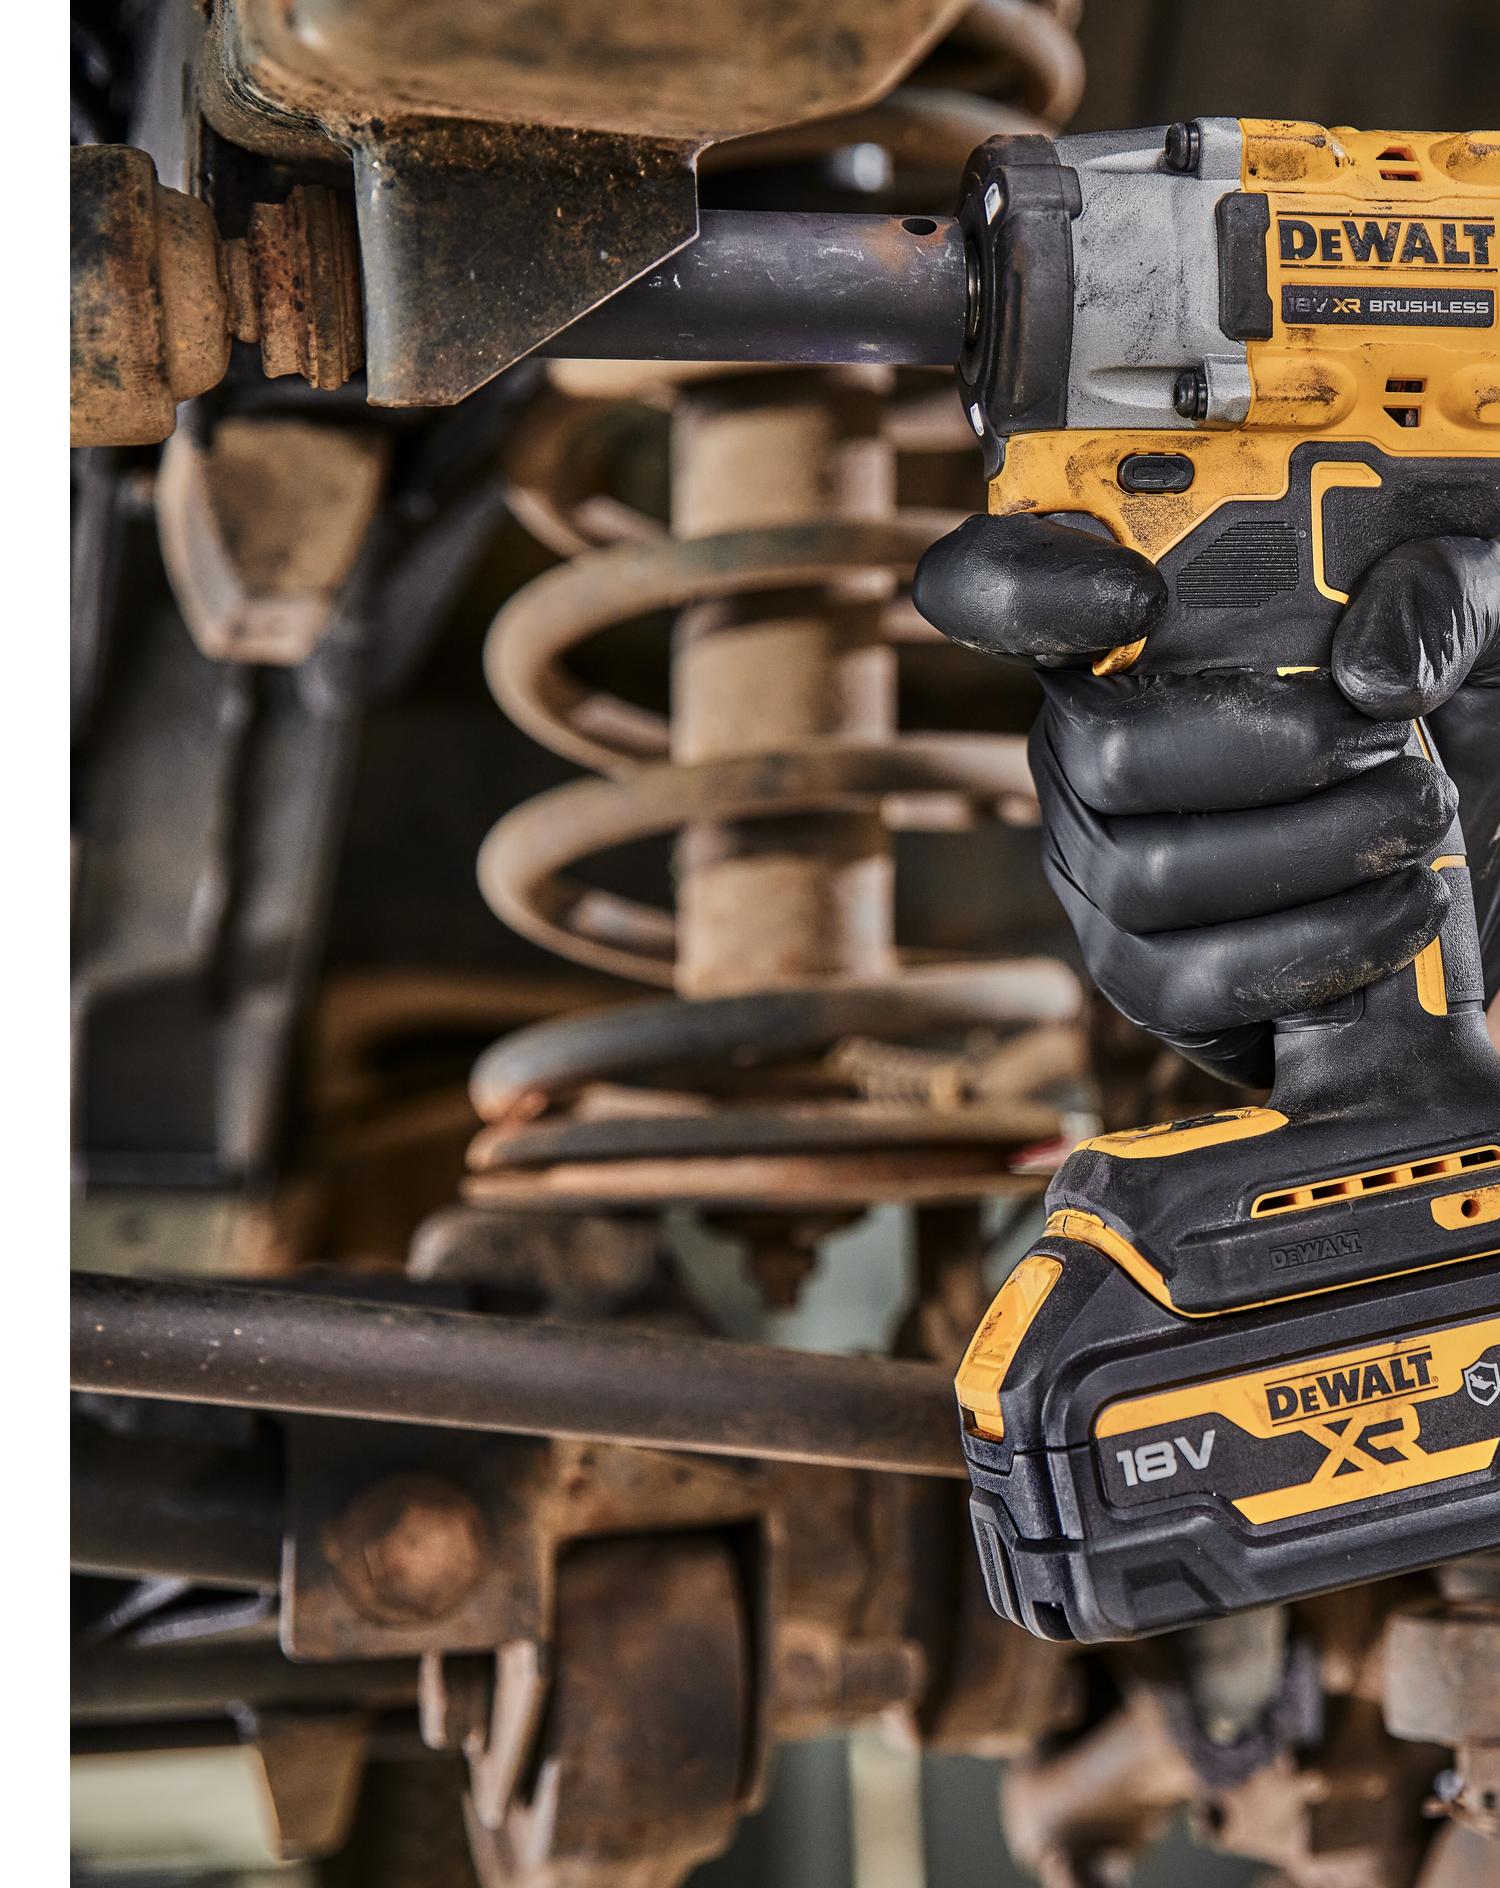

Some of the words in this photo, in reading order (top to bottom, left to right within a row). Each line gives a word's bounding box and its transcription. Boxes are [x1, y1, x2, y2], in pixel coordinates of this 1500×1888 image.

[1277, 219, 1496, 265] DEWALT
[1332, 297, 1361, 314] XR
[1369, 299, 1489, 315] BRUSHLESS
[1265, 1351, 1433, 1421] DEWALT
[1116, 1429, 1216, 1487] 18V
[1302, 1403, 1430, 1484] XR
